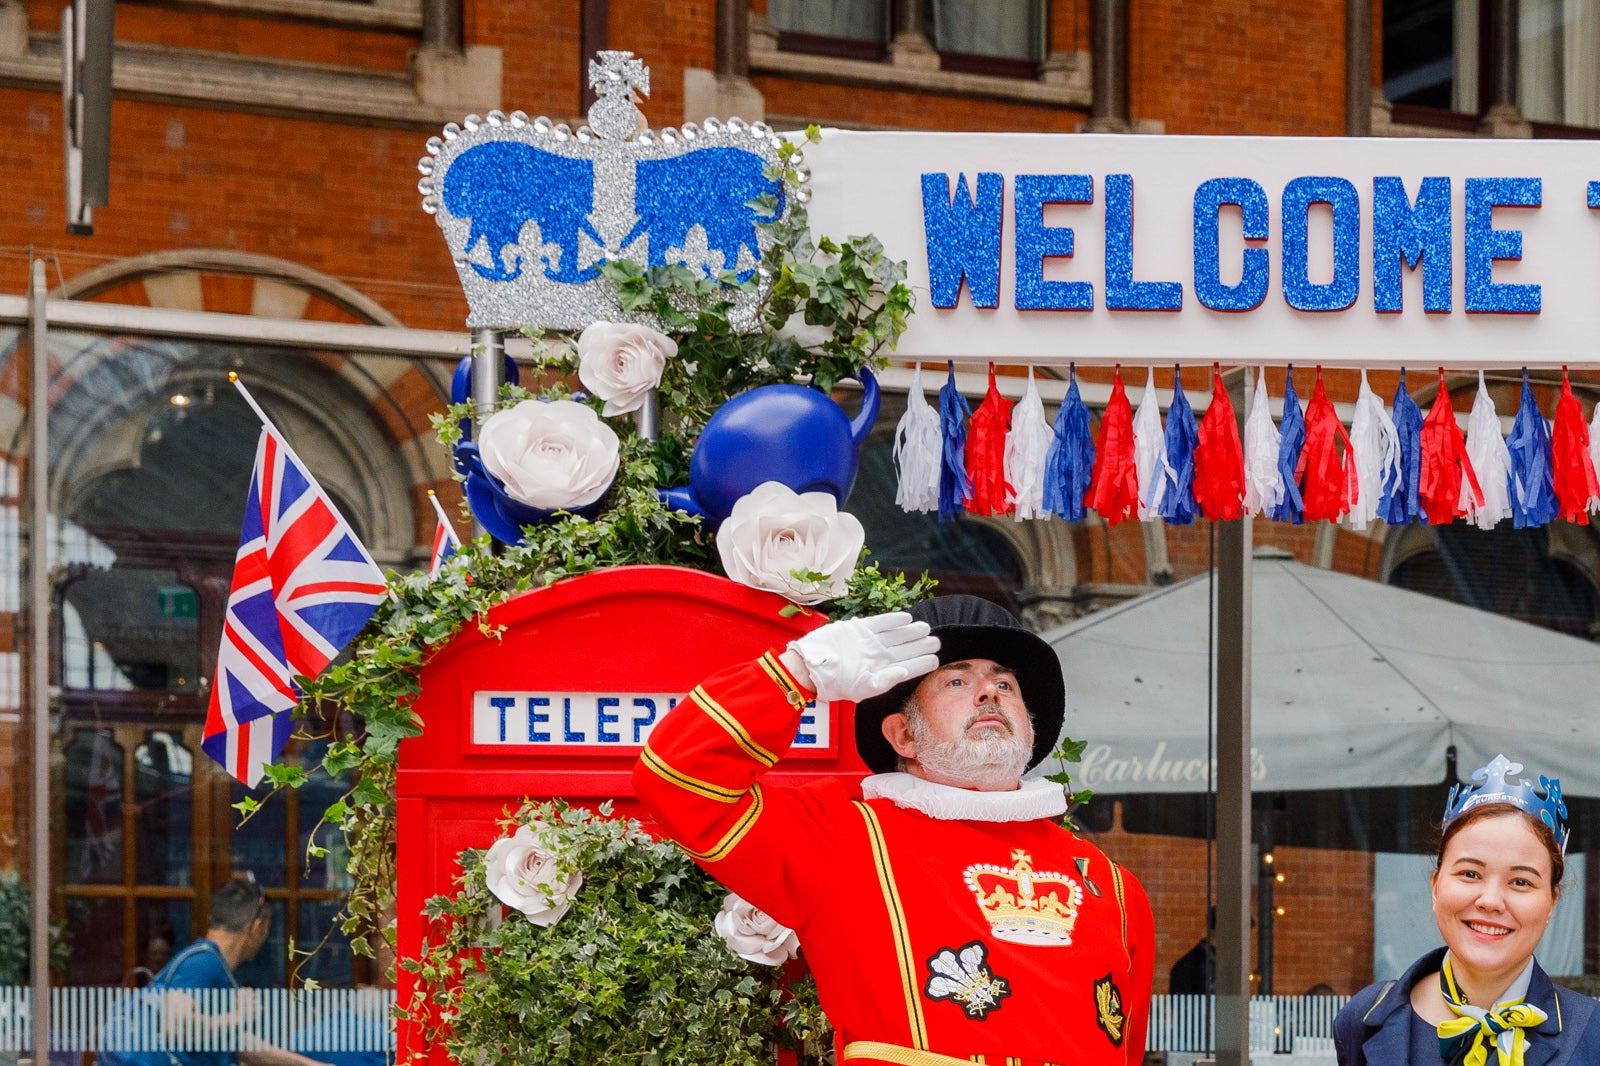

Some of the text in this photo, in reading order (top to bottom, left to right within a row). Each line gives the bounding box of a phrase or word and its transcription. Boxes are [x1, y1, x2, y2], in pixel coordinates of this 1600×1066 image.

[920, 171, 1544, 315] WELCOME
[490, 697, 817, 745] TELEPE
[1475, 794, 1525, 806] EUROSTAR
